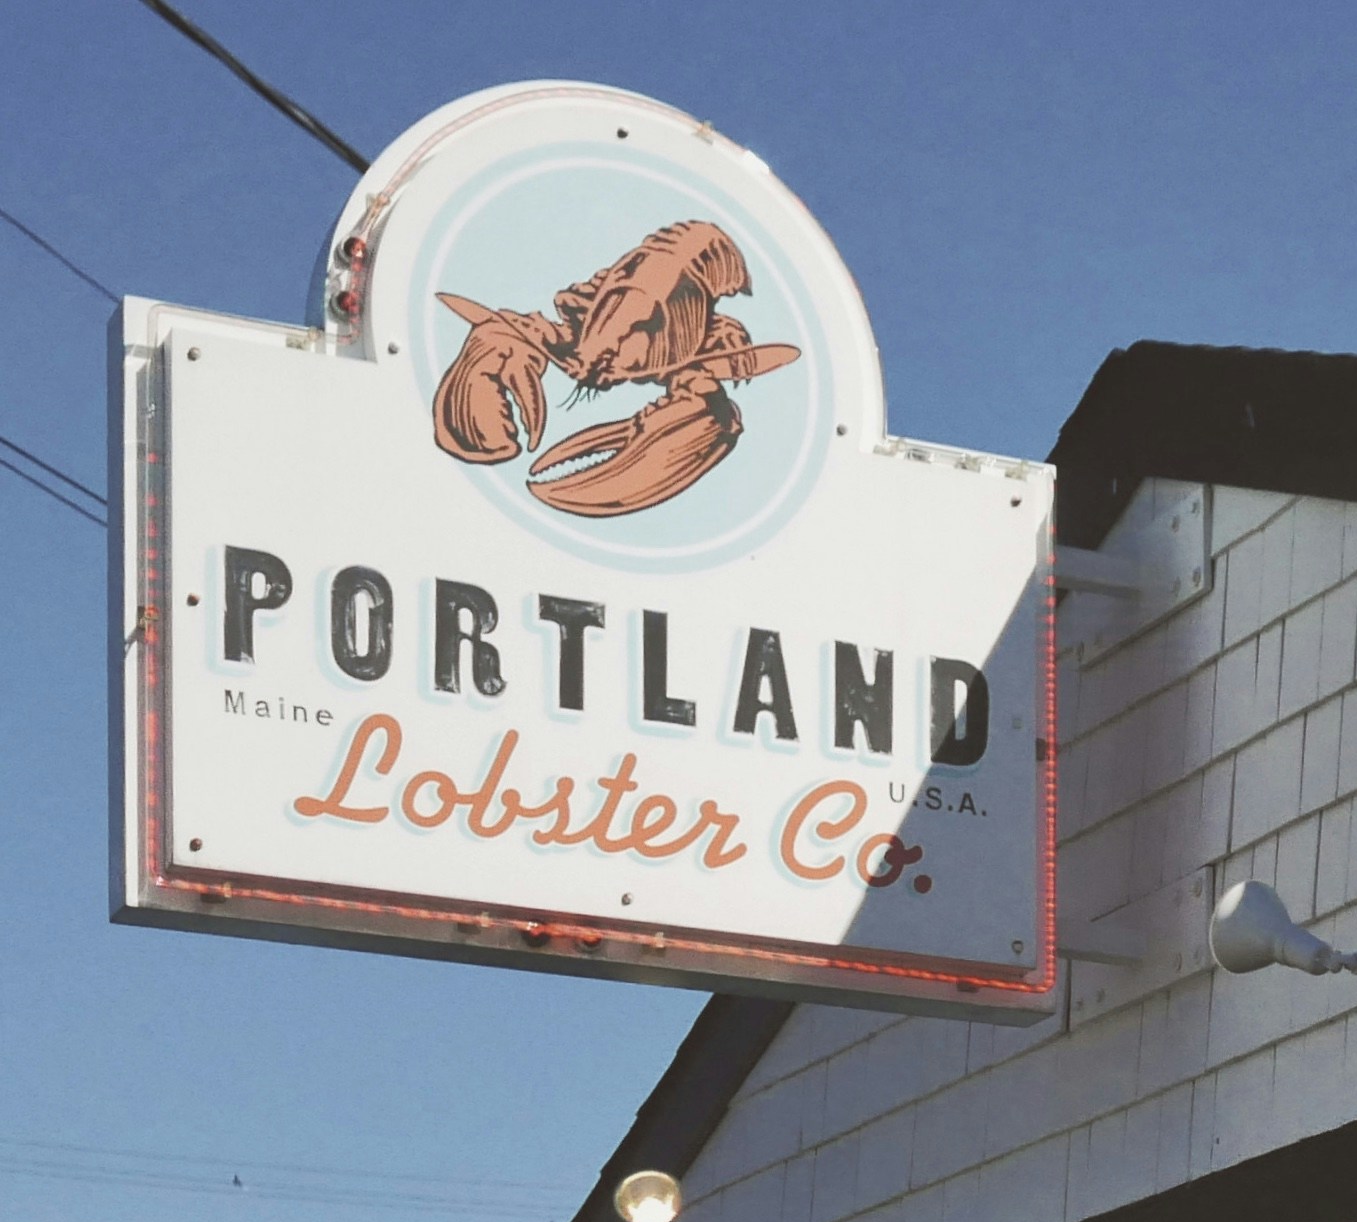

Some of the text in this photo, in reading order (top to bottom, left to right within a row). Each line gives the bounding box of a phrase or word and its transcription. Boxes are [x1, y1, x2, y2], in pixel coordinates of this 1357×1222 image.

[223, 545, 990, 767] PORTLAND
[224, 689, 334, 726] Maine
[294, 713, 932, 894] Lobster Co.
[889, 781, 987, 817] U.S.A.
